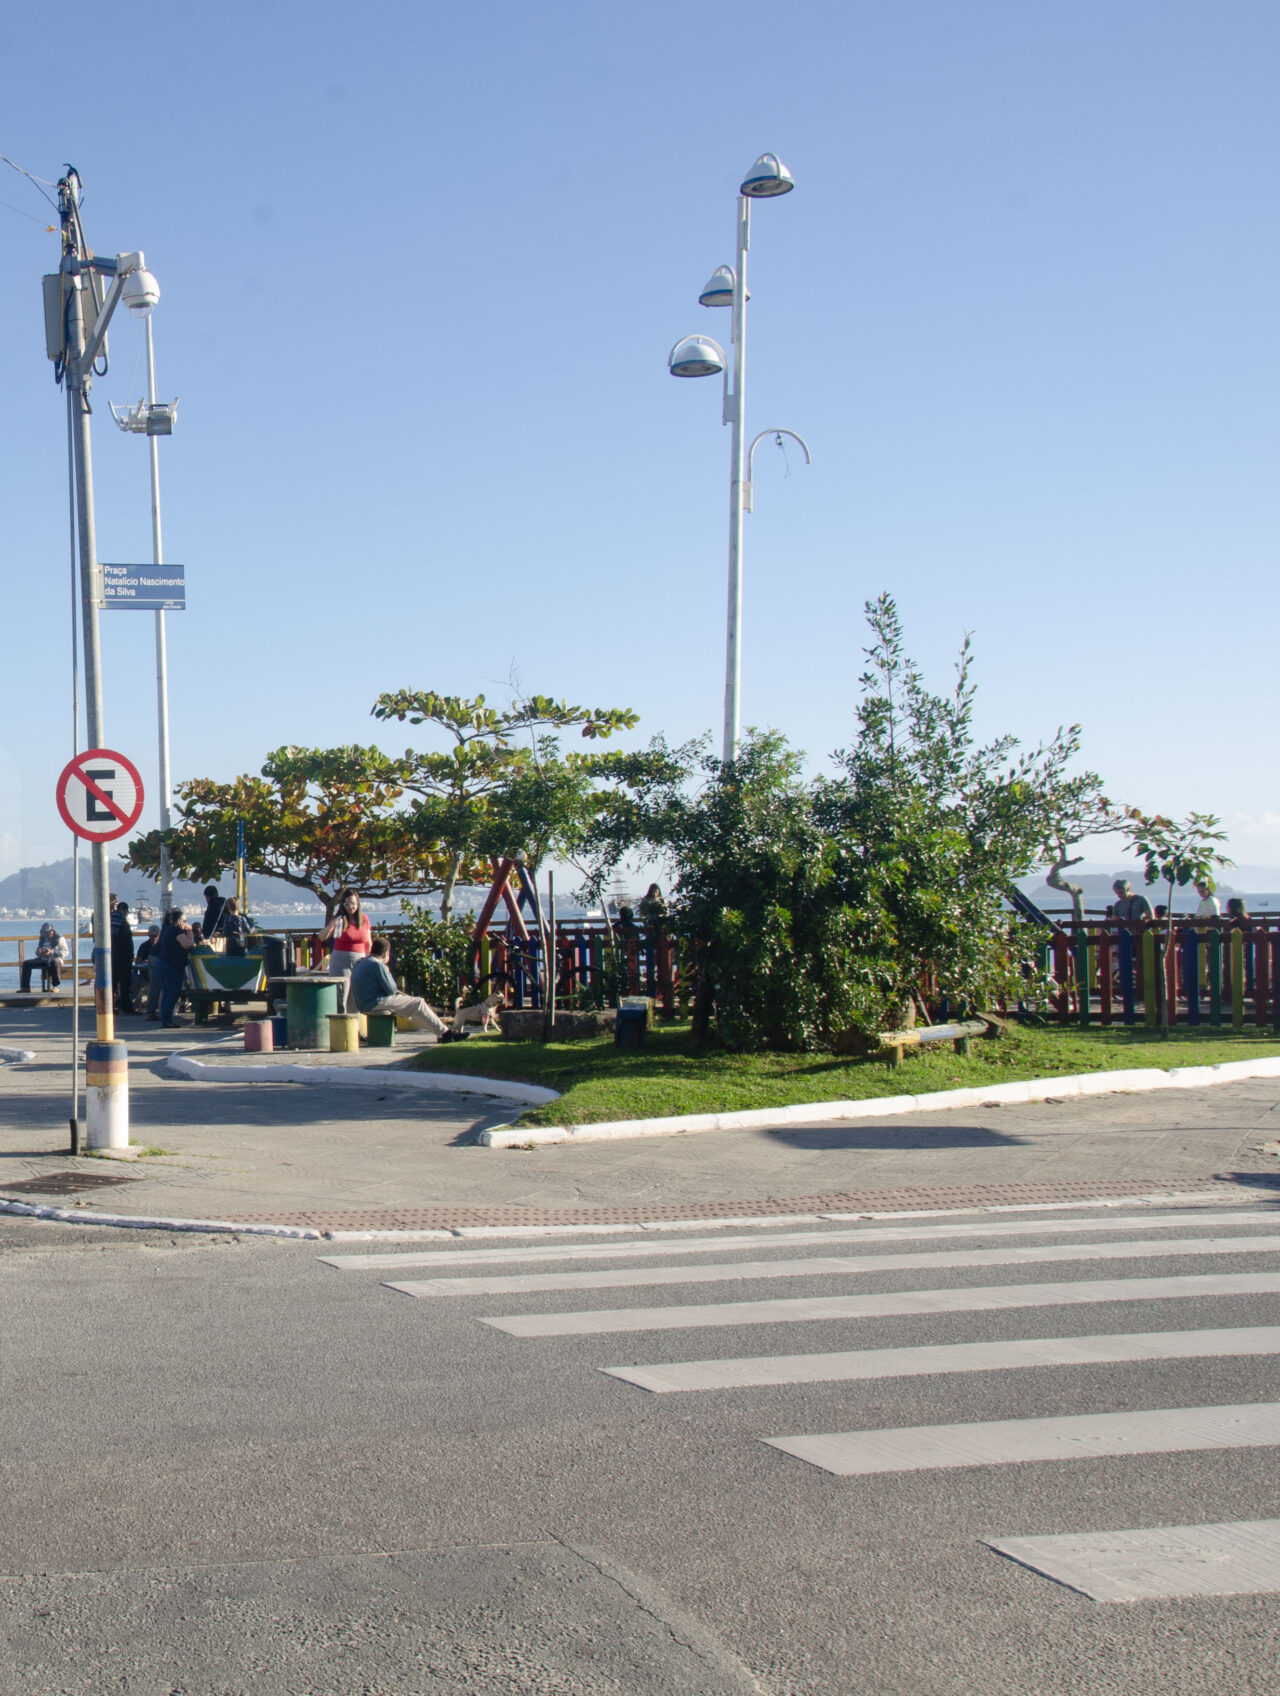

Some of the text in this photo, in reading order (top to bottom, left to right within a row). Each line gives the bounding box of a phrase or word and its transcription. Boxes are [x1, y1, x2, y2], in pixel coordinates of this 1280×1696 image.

[104, 566, 127, 576] Praça
[140, 577, 185, 586] Nascimento
[104, 587, 135, 596] da Silva
[85, 769, 117, 822] E
